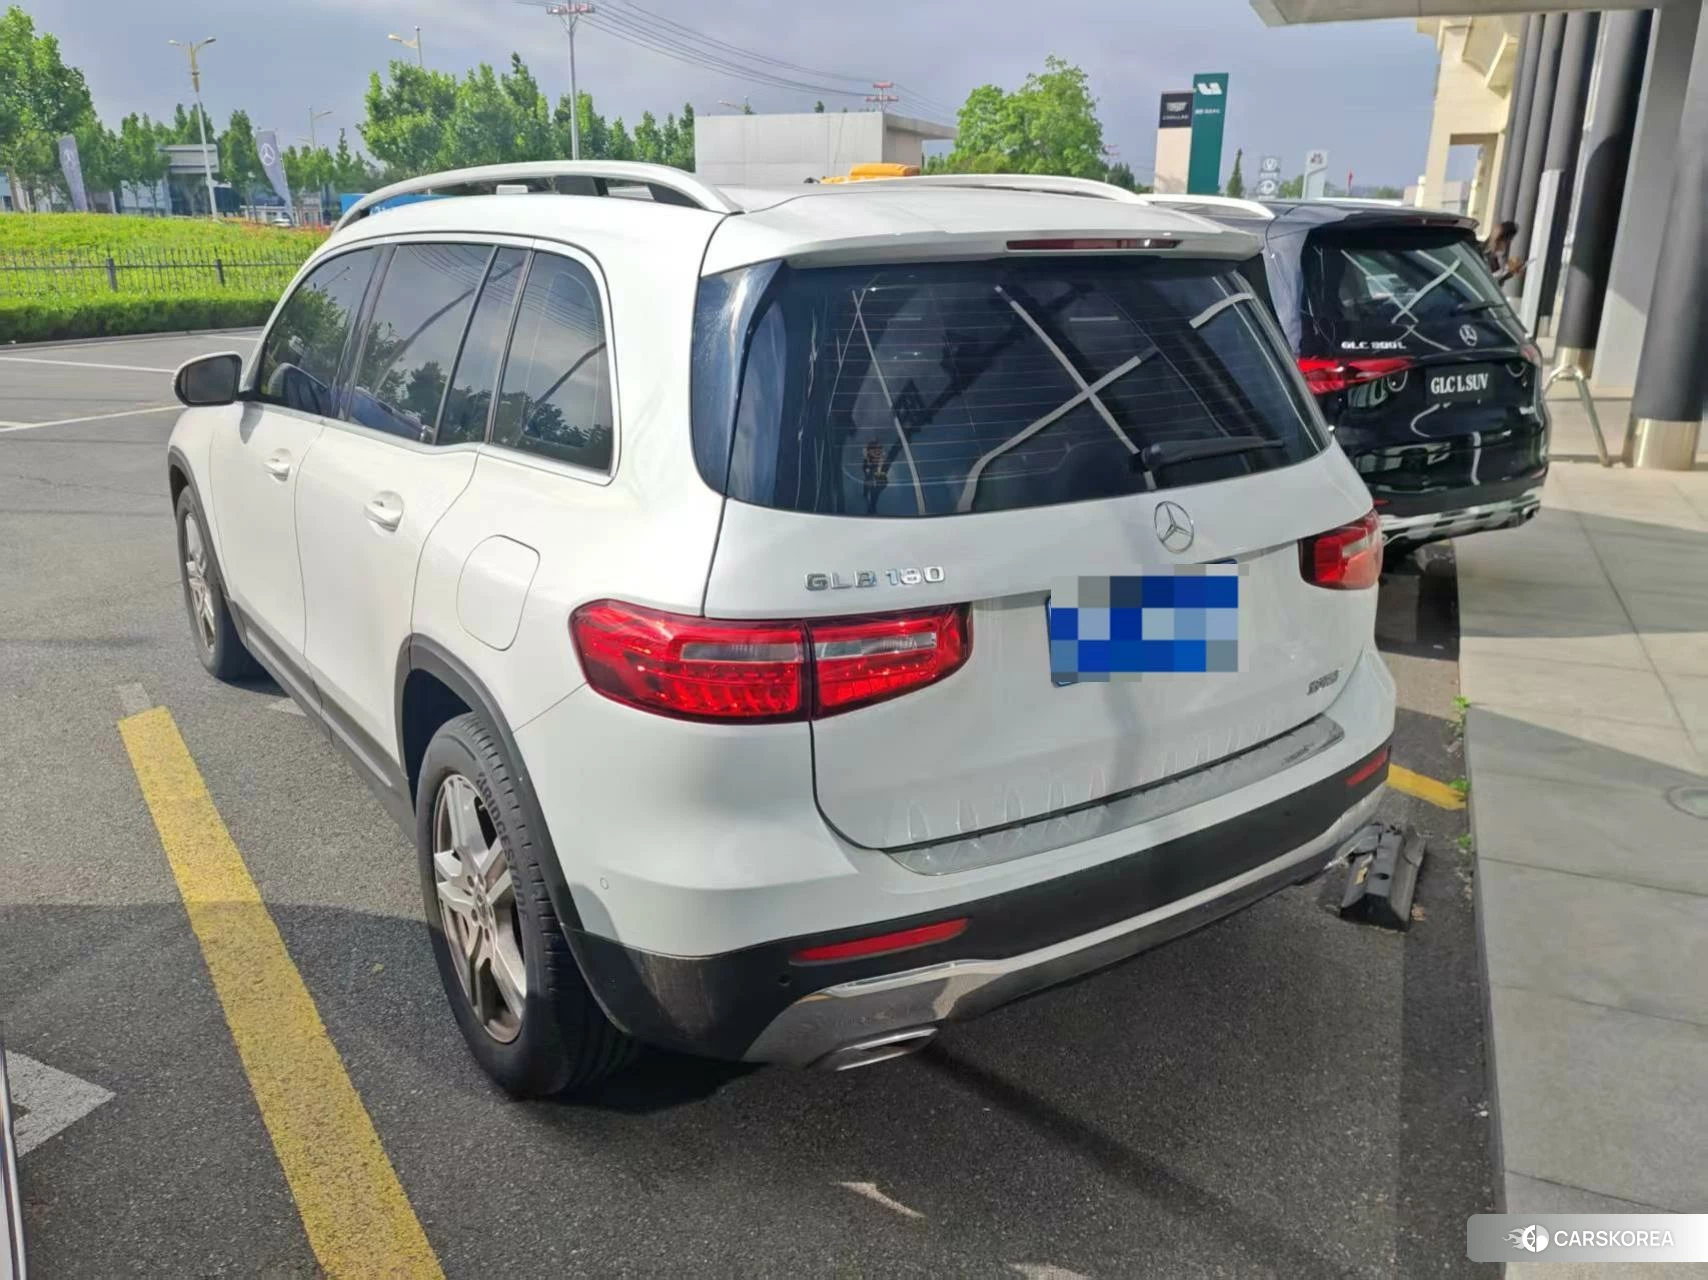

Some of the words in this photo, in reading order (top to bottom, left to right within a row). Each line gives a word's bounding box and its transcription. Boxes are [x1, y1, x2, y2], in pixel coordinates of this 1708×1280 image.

[1341, 341, 1369, 349] GLC
[1431, 375, 1455, 394] GLC
[805, 569, 877, 591] GLB
[885, 565, 945, 586] 180
